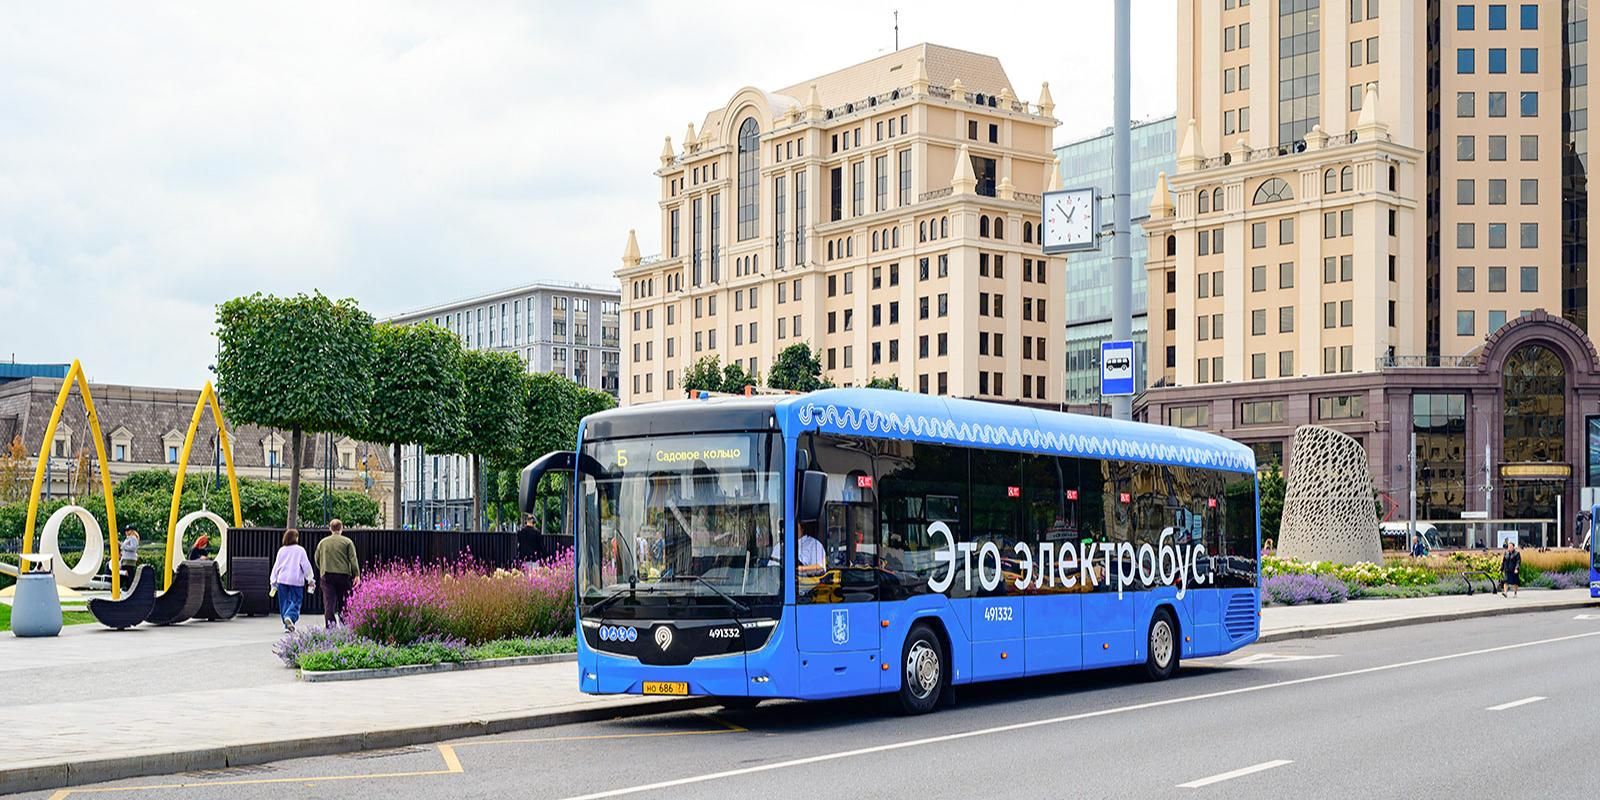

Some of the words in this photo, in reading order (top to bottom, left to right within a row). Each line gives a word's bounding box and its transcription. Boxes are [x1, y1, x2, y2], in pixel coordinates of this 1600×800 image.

[617, 449, 628, 467] Б
[655, 450, 700, 463] Садовое
[703, 448, 741, 459] кольцо
[927, 520, 1002, 593] Это
[1013, 526, 1214, 601] электробус.
[984, 605, 1013, 621] 491332
[708, 628, 740, 639] 491332
[659, 683, 674, 693] 686
